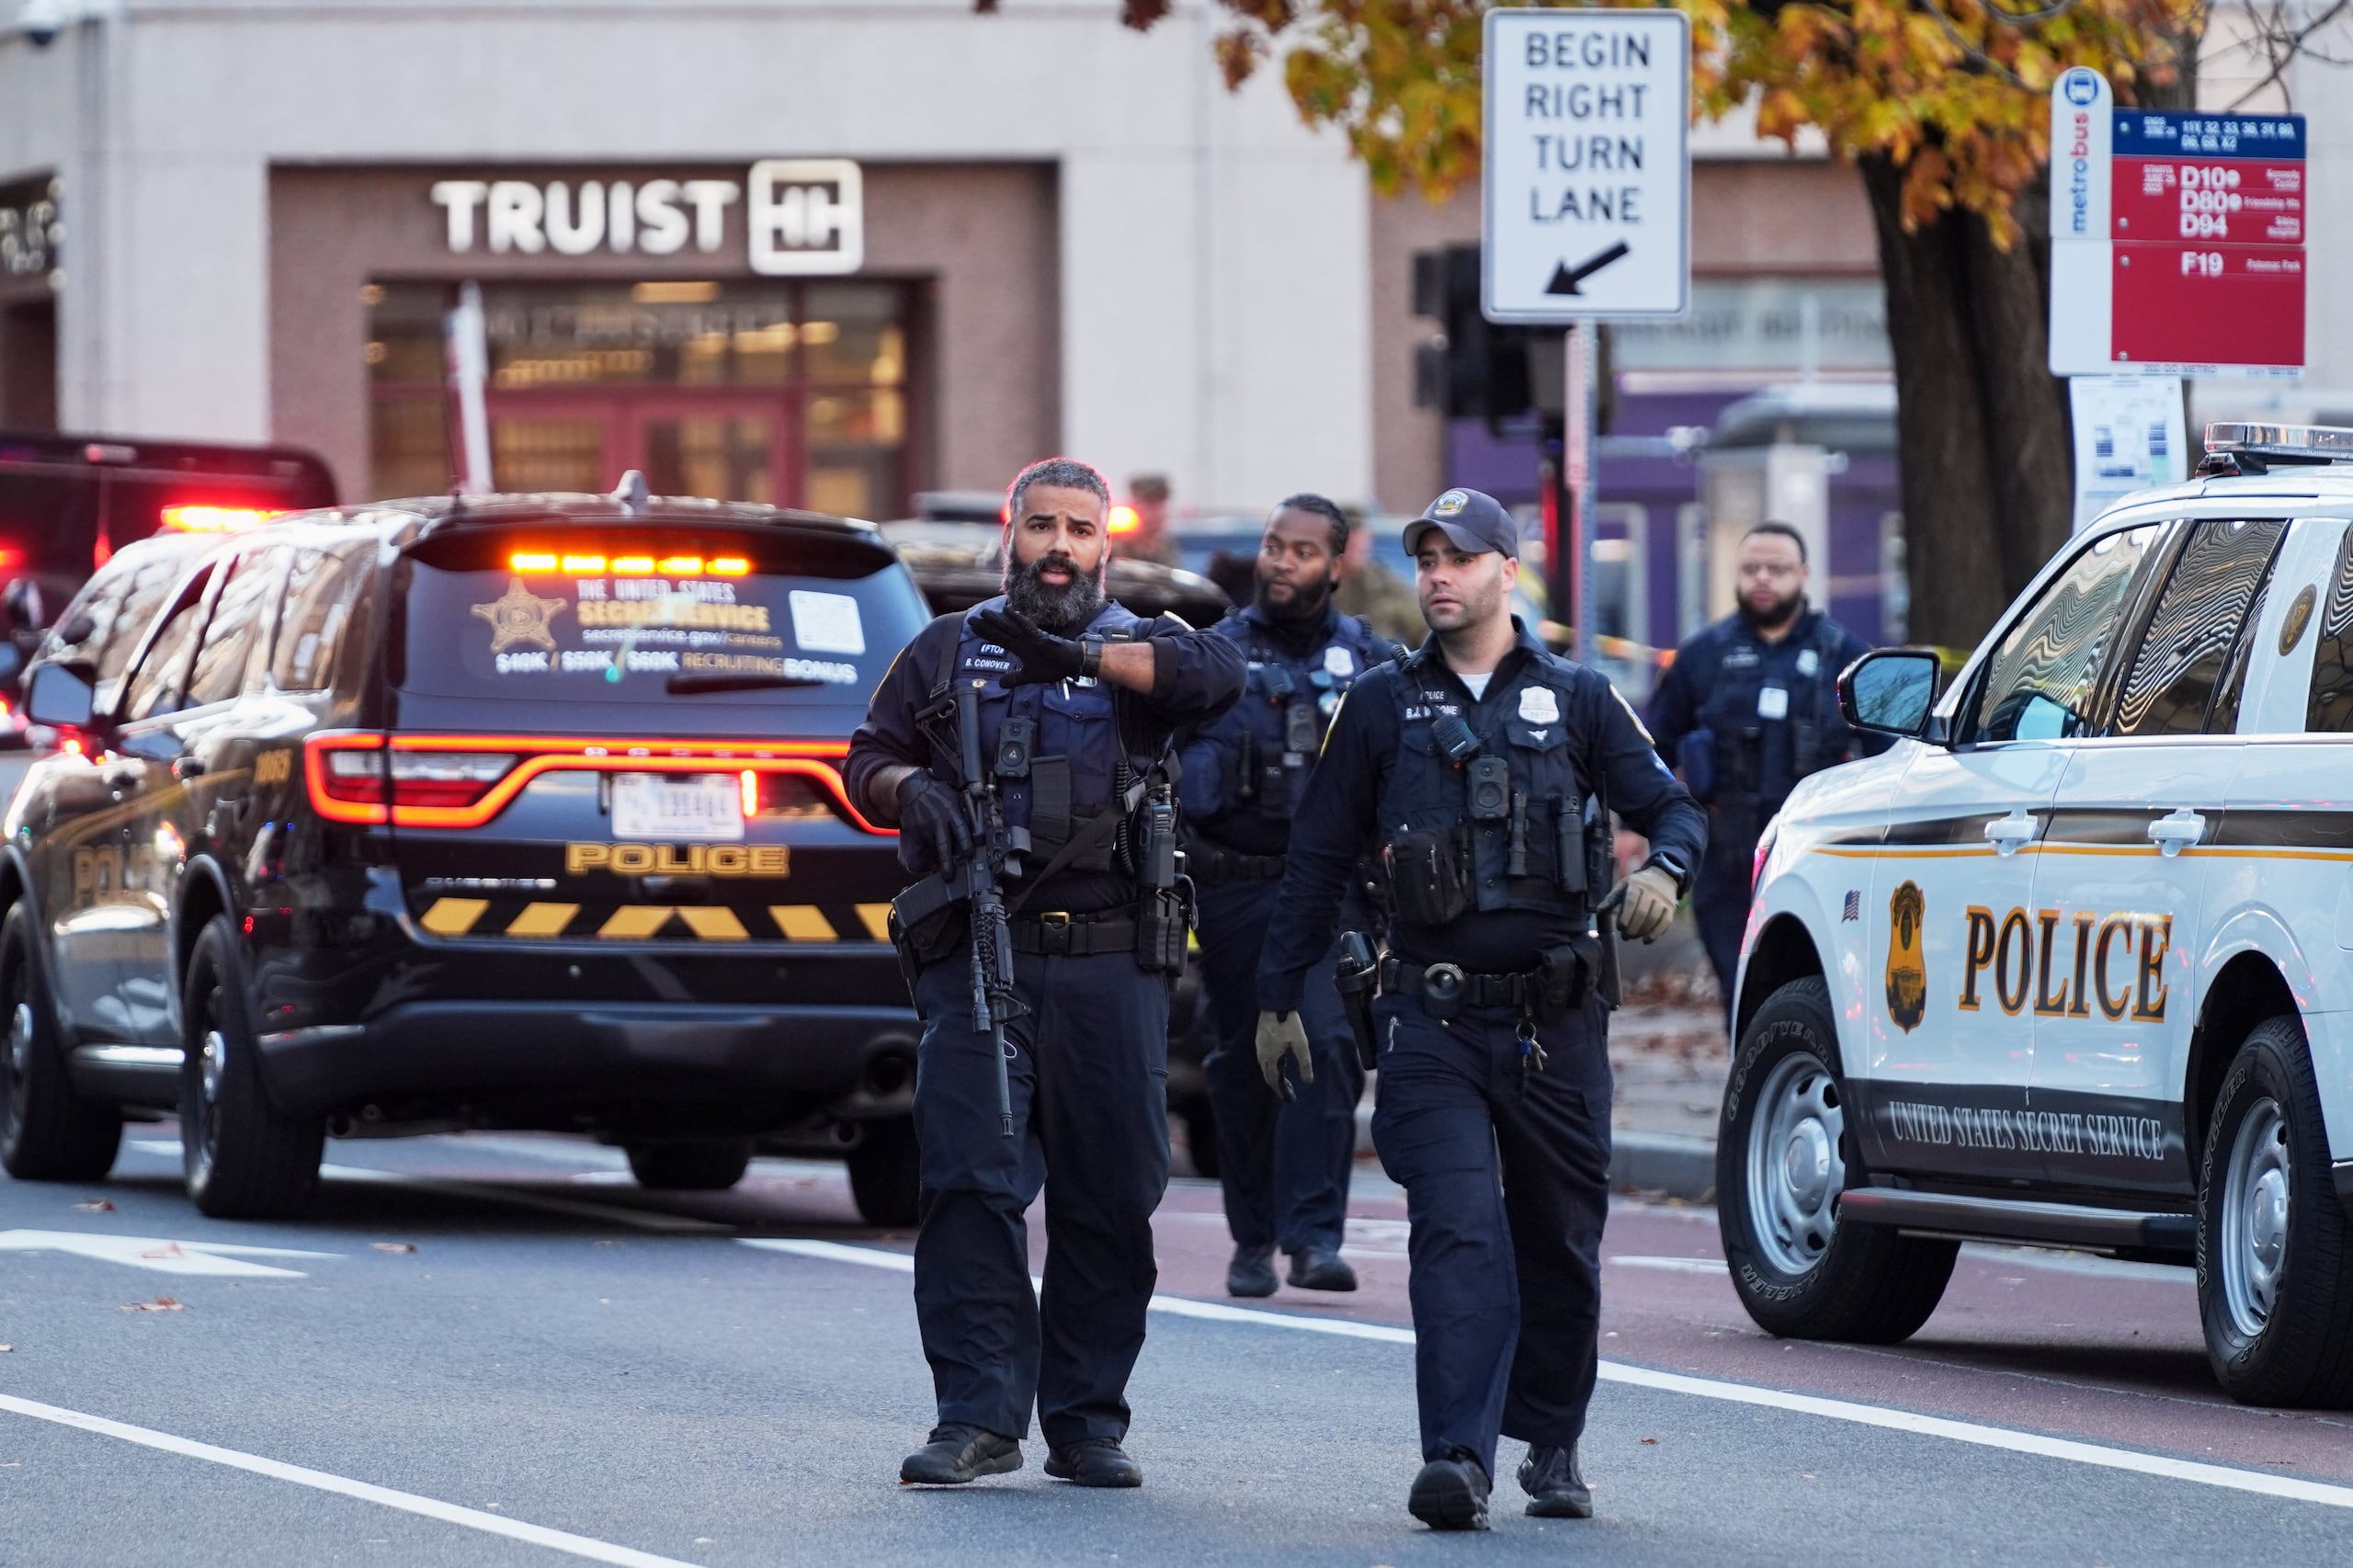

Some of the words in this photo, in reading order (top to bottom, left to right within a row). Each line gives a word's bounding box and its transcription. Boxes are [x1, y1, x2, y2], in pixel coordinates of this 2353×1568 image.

[1525, 31, 1650, 67] BEGIN
[1525, 84, 1647, 119] RIGHT
[1532, 135, 1643, 170] TURN
[2070, 111, 2089, 232] metrobus
[2180, 165, 2226, 189] D10
[431, 179, 739, 256] TRUIST
[1529, 187, 1641, 222] LANE
[2180, 189, 2228, 213] D80
[2180, 212, 2227, 237] D94
[2181, 250, 2223, 278] F19
[577, 578, 608, 600] THE
[614, 578, 671, 601] UNITED
[678, 580, 735, 604] STATES
[682, 651, 782, 674] RECRUITING
[783, 656, 858, 686] BONUS
[965, 657, 972, 666] B.
[974, 658, 1010, 670] CONOVER
[565, 841, 790, 877] POLICE
[1959, 904, 2174, 1023] POLICE
[1727, 1020, 1830, 1121] GOODYEAR
[1889, 1100, 1952, 1145] UNITED
[1952, 1107, 2016, 1150] STATES
[2017, 1110, 2084, 1154] SECRET
[2086, 1114, 2165, 1161] SERVICE
